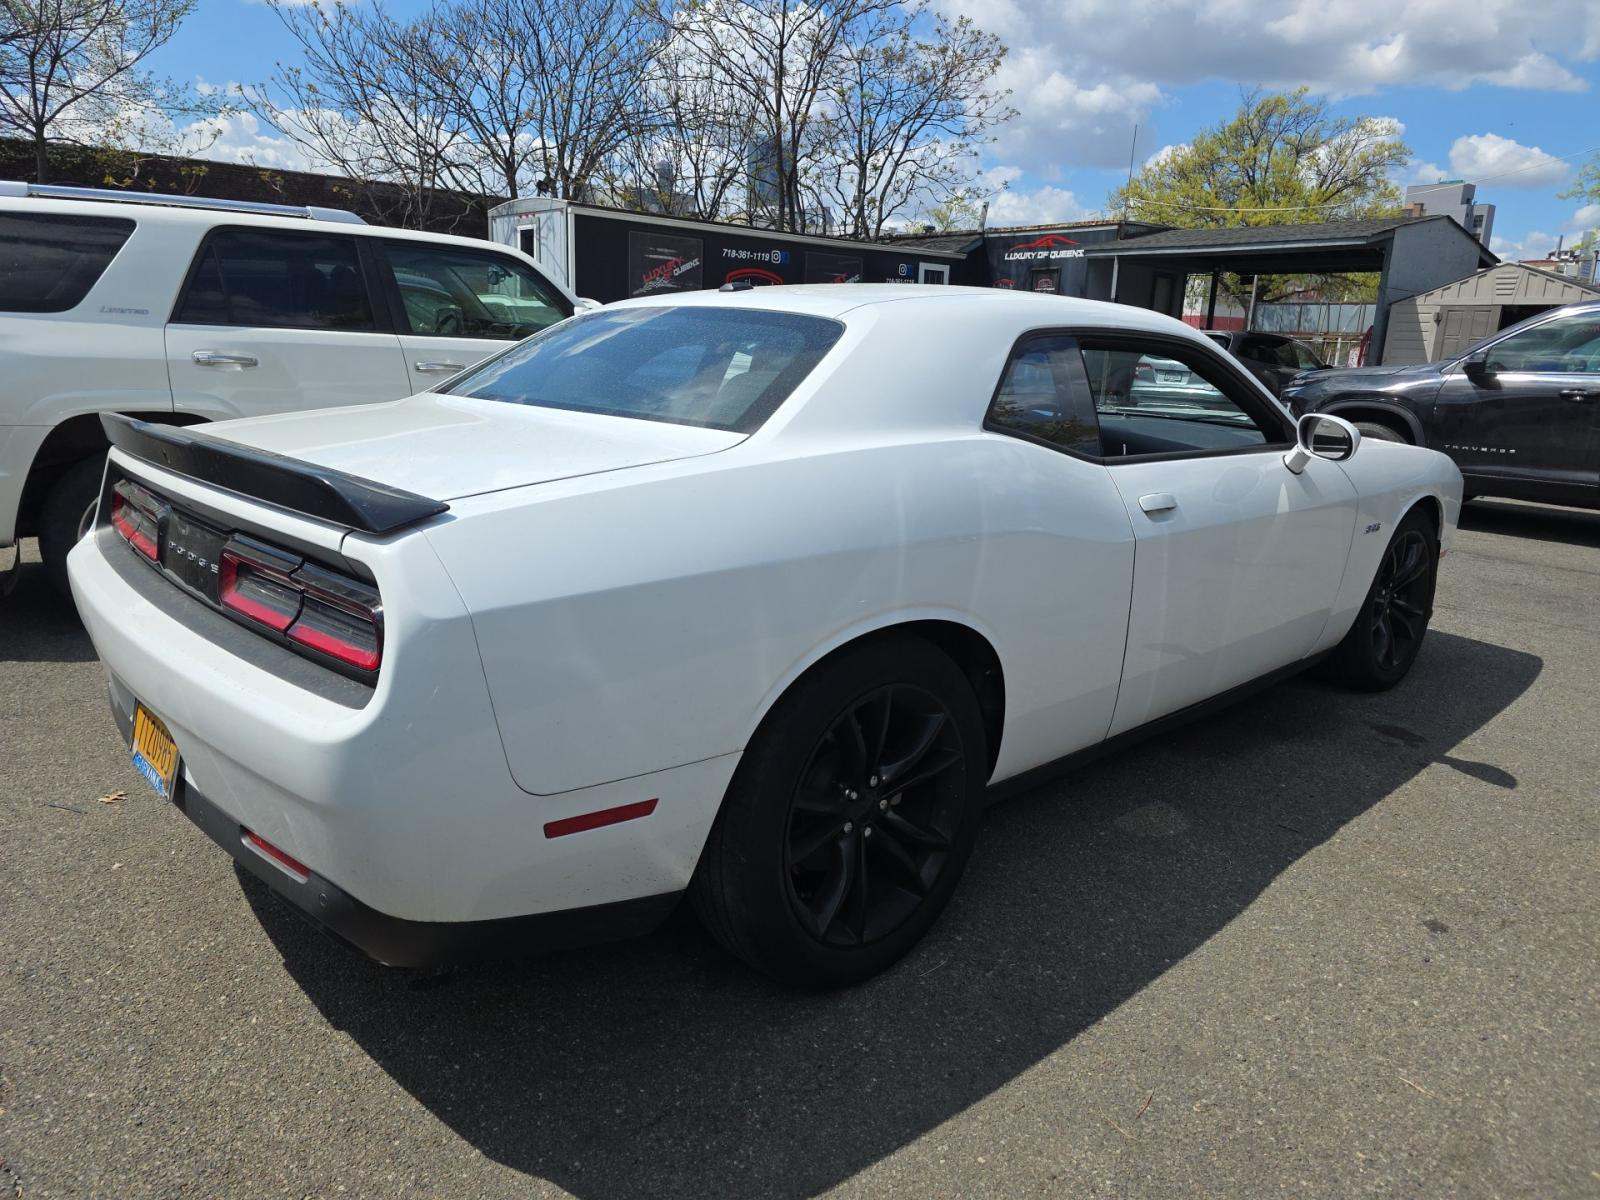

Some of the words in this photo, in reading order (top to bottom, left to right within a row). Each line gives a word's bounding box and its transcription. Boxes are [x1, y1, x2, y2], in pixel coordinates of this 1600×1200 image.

[722, 248, 770, 261] 718-361-1119
[1004, 251, 1037, 260] LUXURY
[1037, 251, 1050, 259] OF
[1050, 249, 1085, 259] QUEENS
[1444, 443, 1516, 454] TRAVERSE
[168, 540, 219, 574] DODGE
